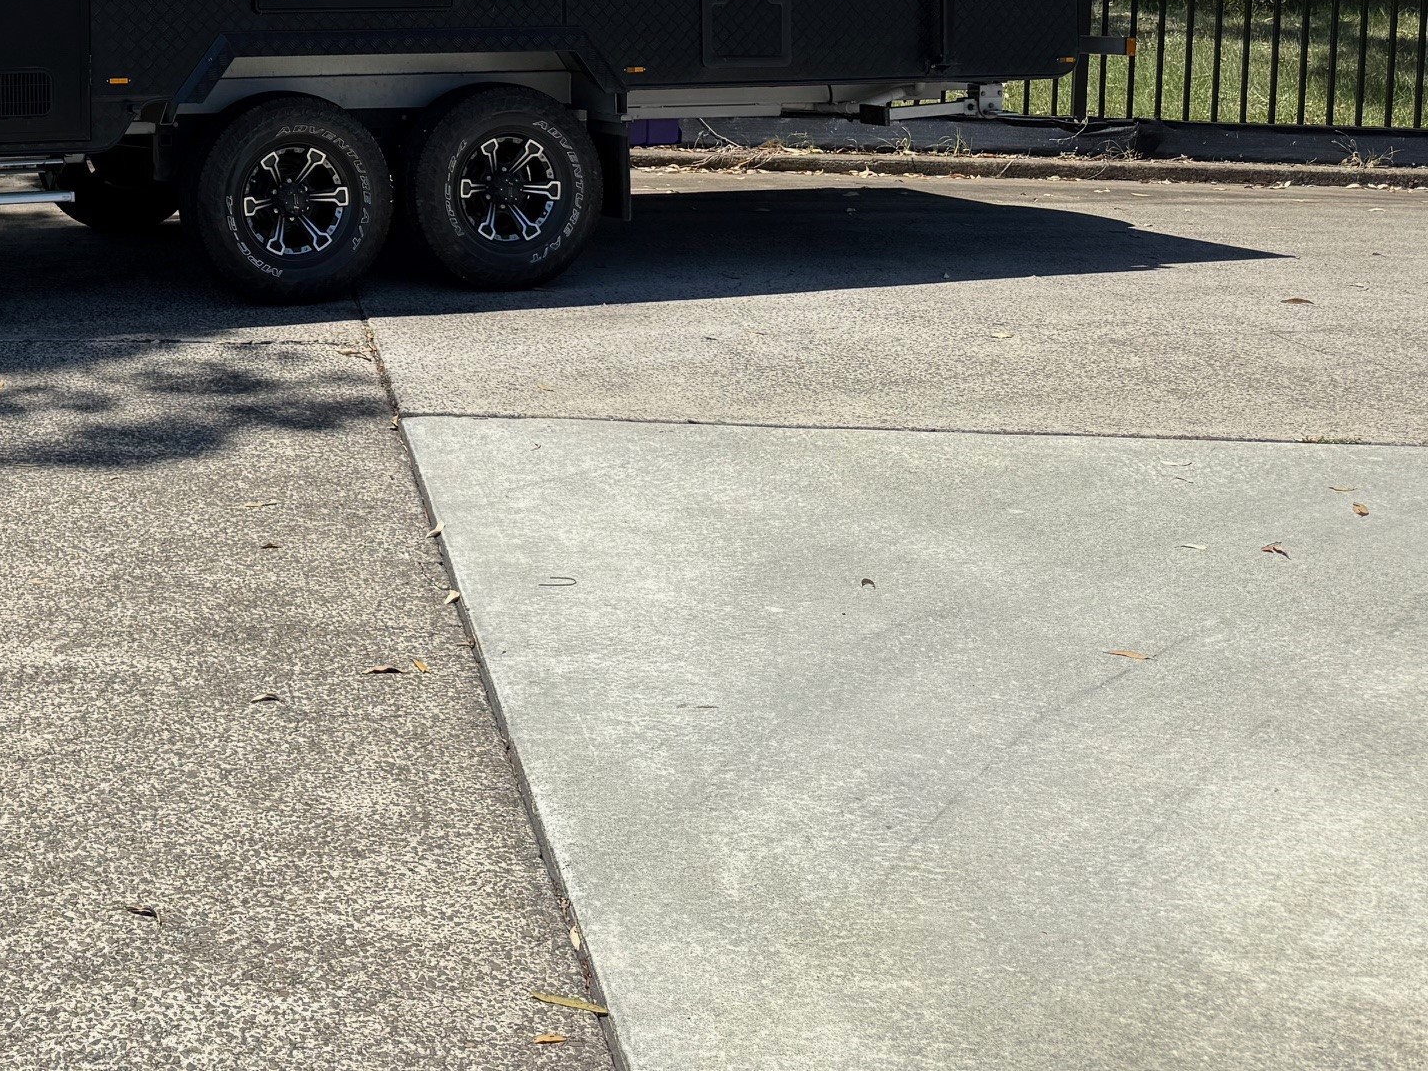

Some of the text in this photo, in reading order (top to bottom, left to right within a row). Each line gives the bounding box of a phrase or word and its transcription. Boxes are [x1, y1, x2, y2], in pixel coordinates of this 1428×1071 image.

[276, 124, 372, 251] ADVENTURE A/T
[529, 120, 584, 264] ADVENTURE A/T
